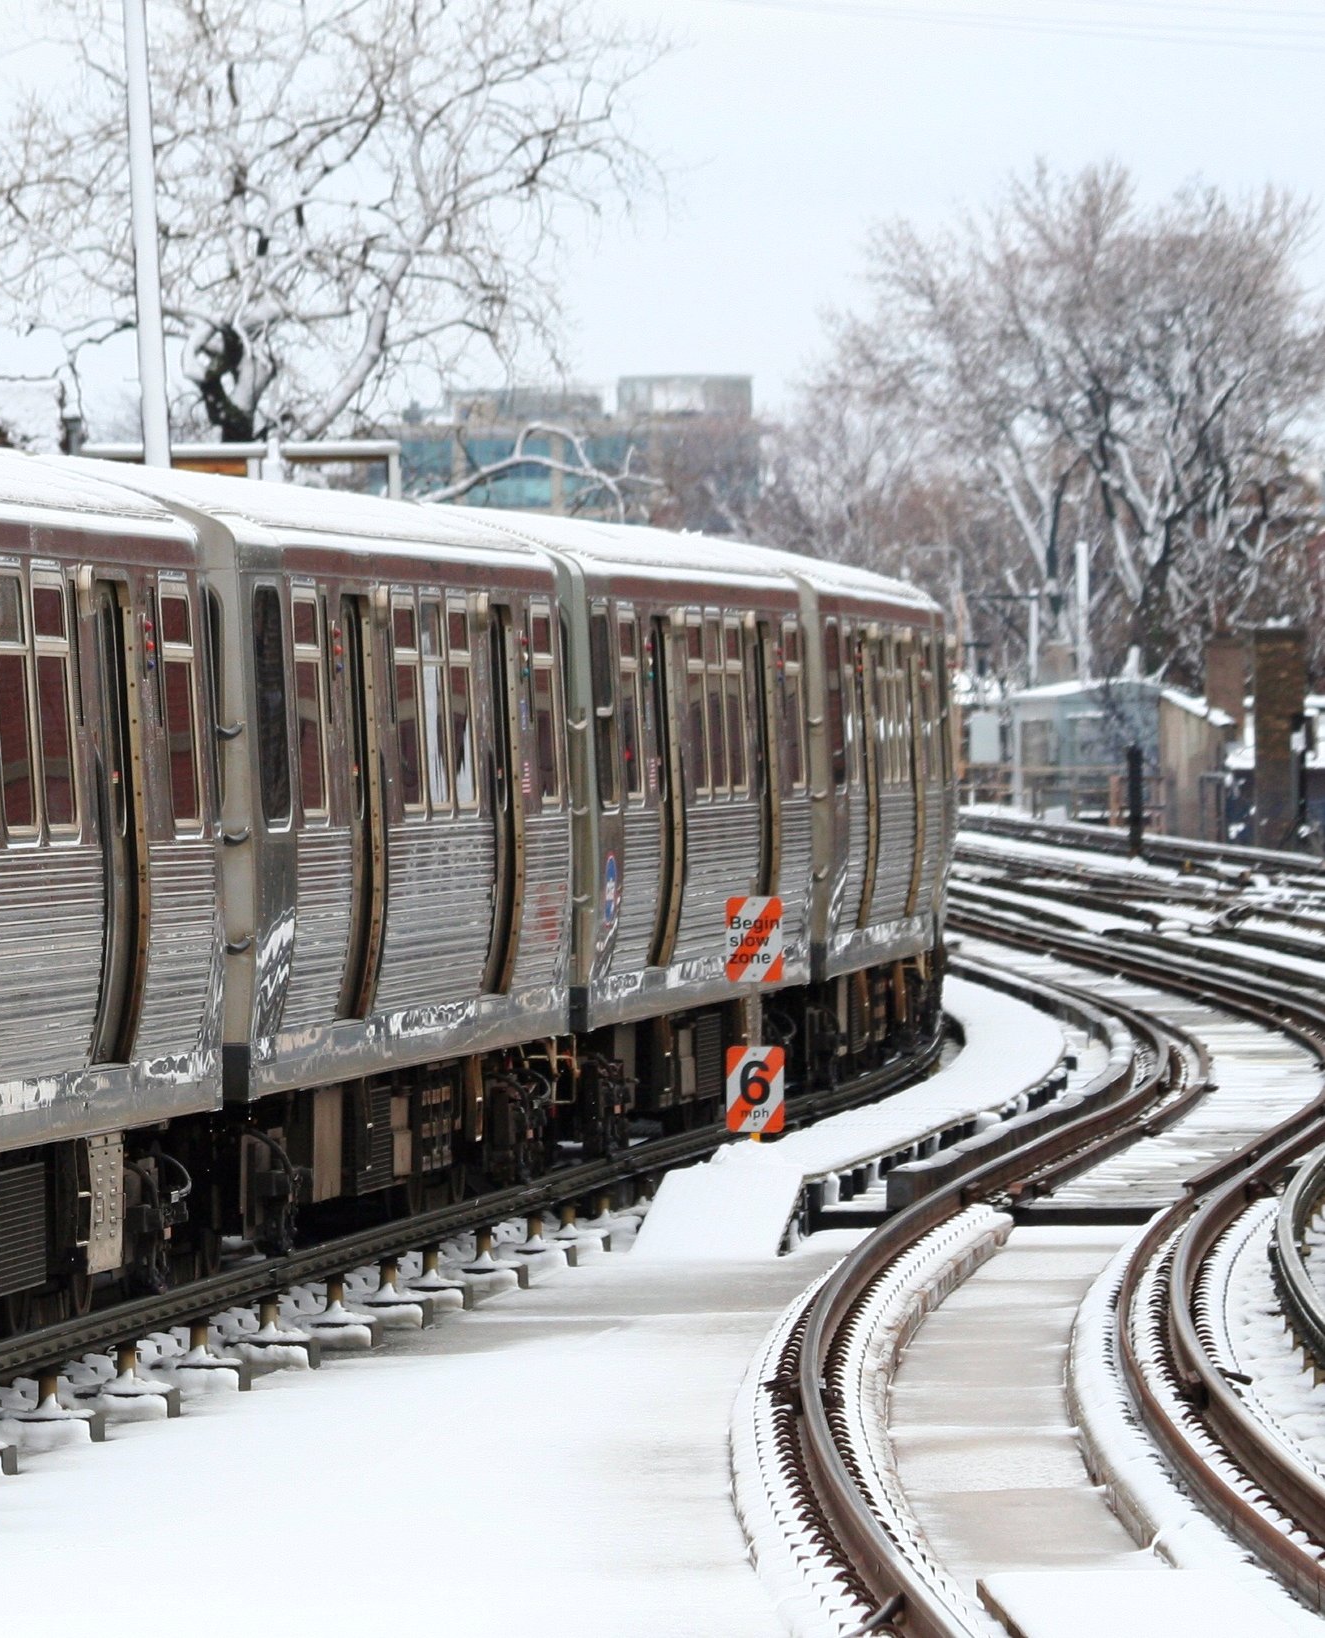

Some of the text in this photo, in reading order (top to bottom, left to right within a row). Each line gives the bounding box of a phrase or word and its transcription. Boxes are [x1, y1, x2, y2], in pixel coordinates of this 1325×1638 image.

[730, 916, 780, 934] Begin
[729, 934, 771, 947] slow
[729, 952, 771, 965] zone
[740, 1061, 771, 1106] 6
[740, 1107, 770, 1120] mph
